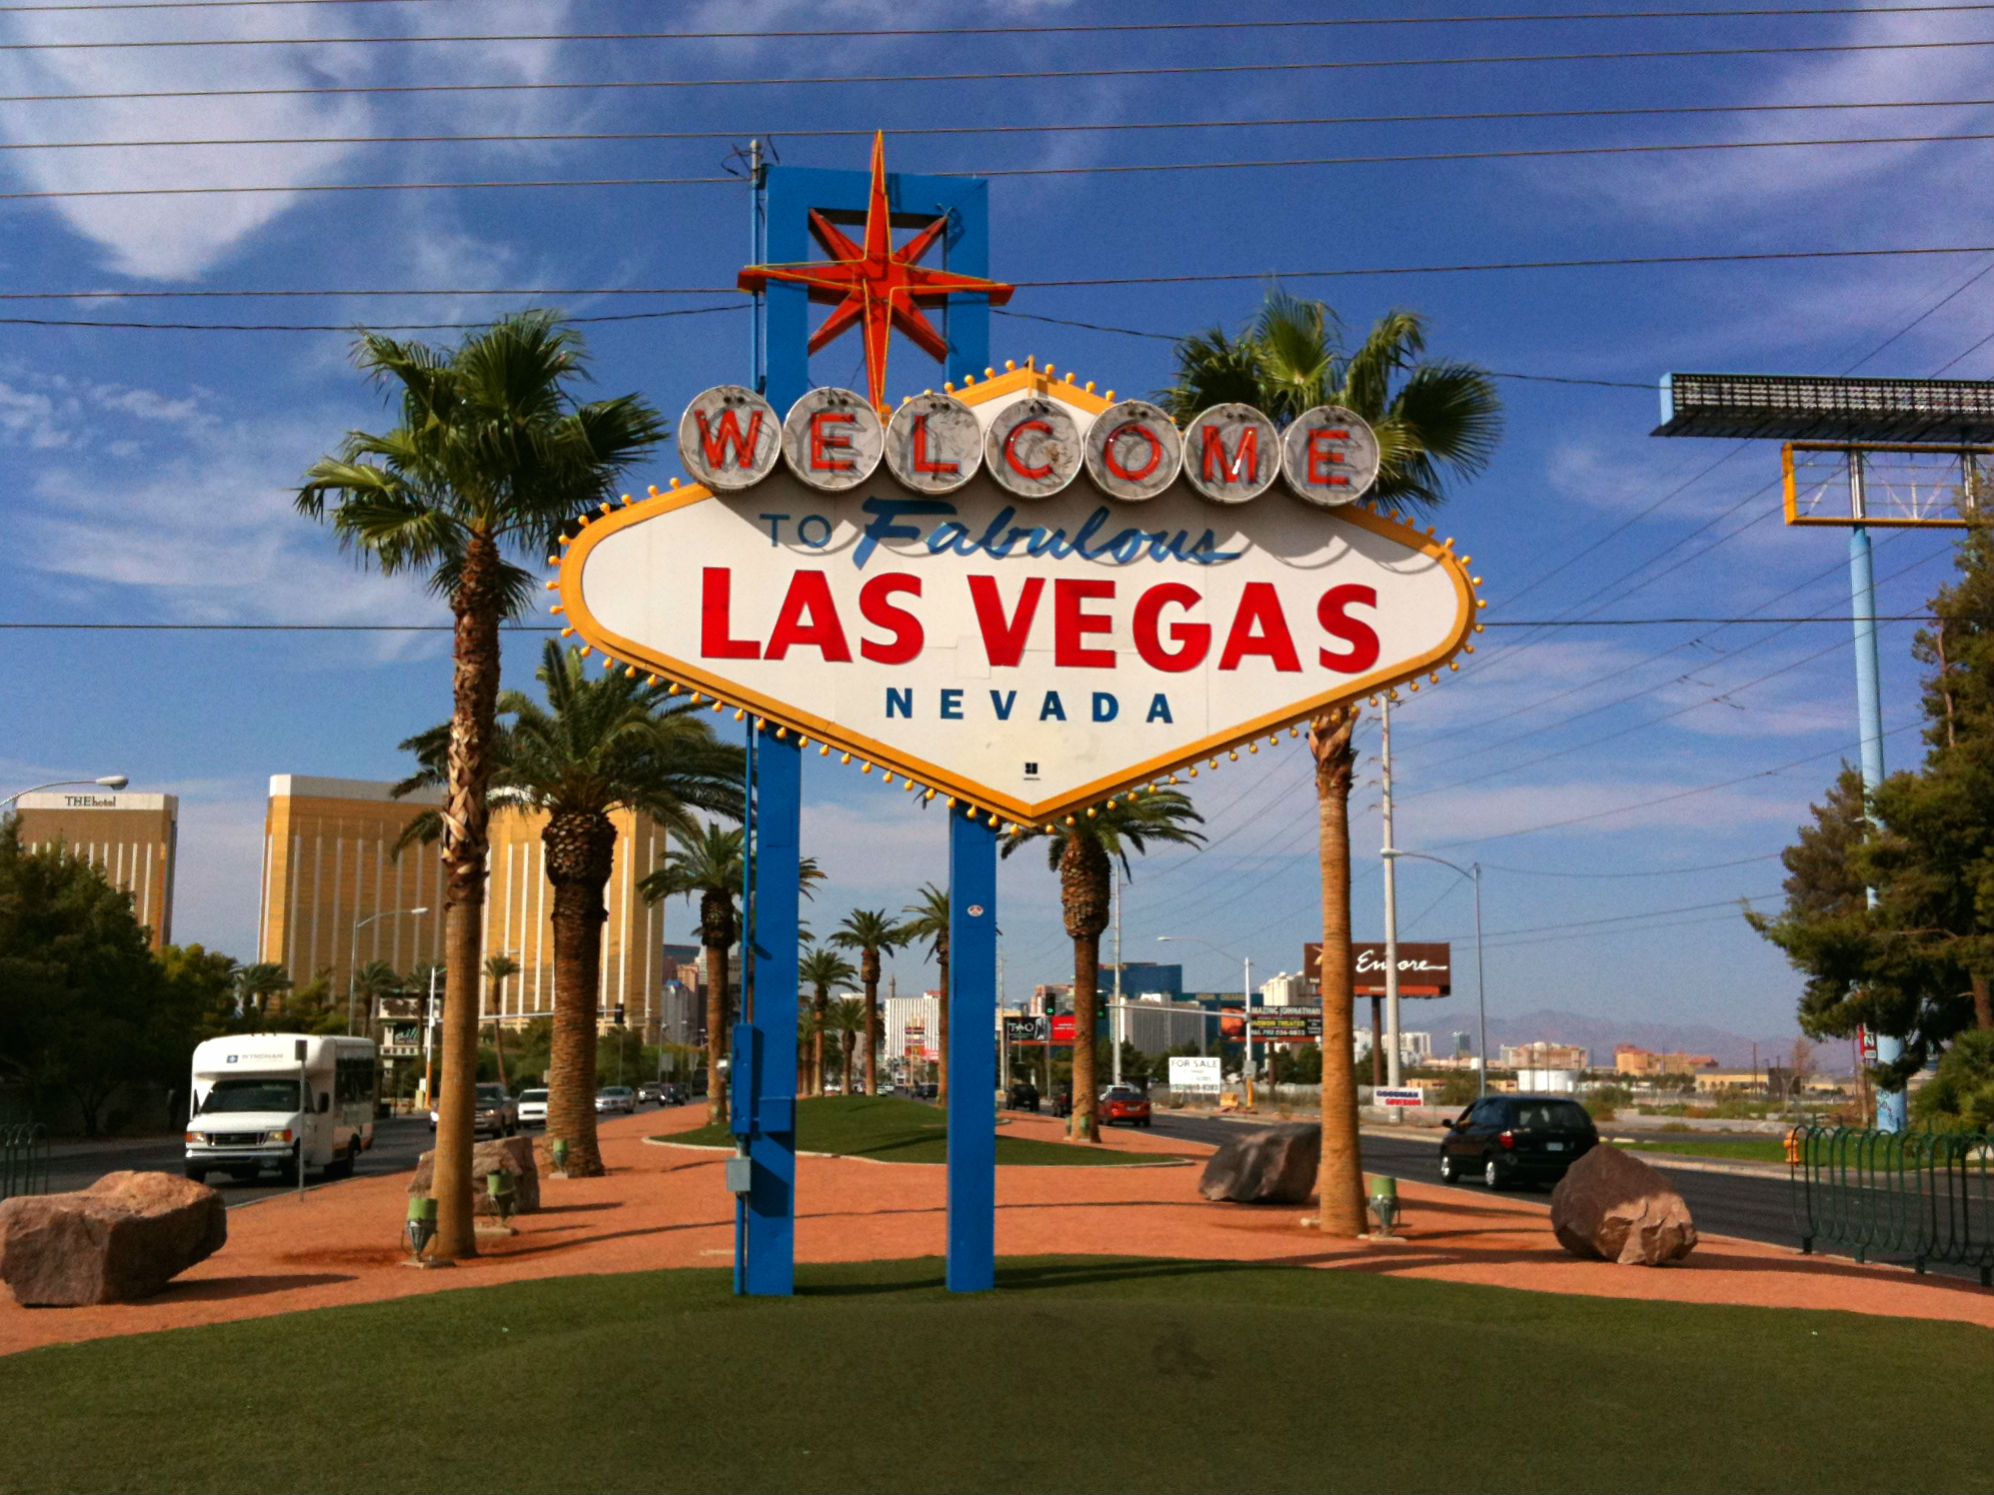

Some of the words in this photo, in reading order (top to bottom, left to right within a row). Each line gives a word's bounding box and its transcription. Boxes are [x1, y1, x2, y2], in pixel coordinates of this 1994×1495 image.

[693, 405, 1352, 487] WELCOME
[759, 513, 833, 549] TO
[851, 495, 1243, 570] Fabulous
[700, 566, 925, 666] LAS
[967, 574, 1381, 675] VEGAS
[885, 687, 1174, 724] NEVADA
[1356, 949, 1448, 973] Enore
[1007, 1022, 1034, 1033] TAO
[1170, 1059, 1190, 1067] FOR
[1193, 1059, 1217, 1068] SALE
